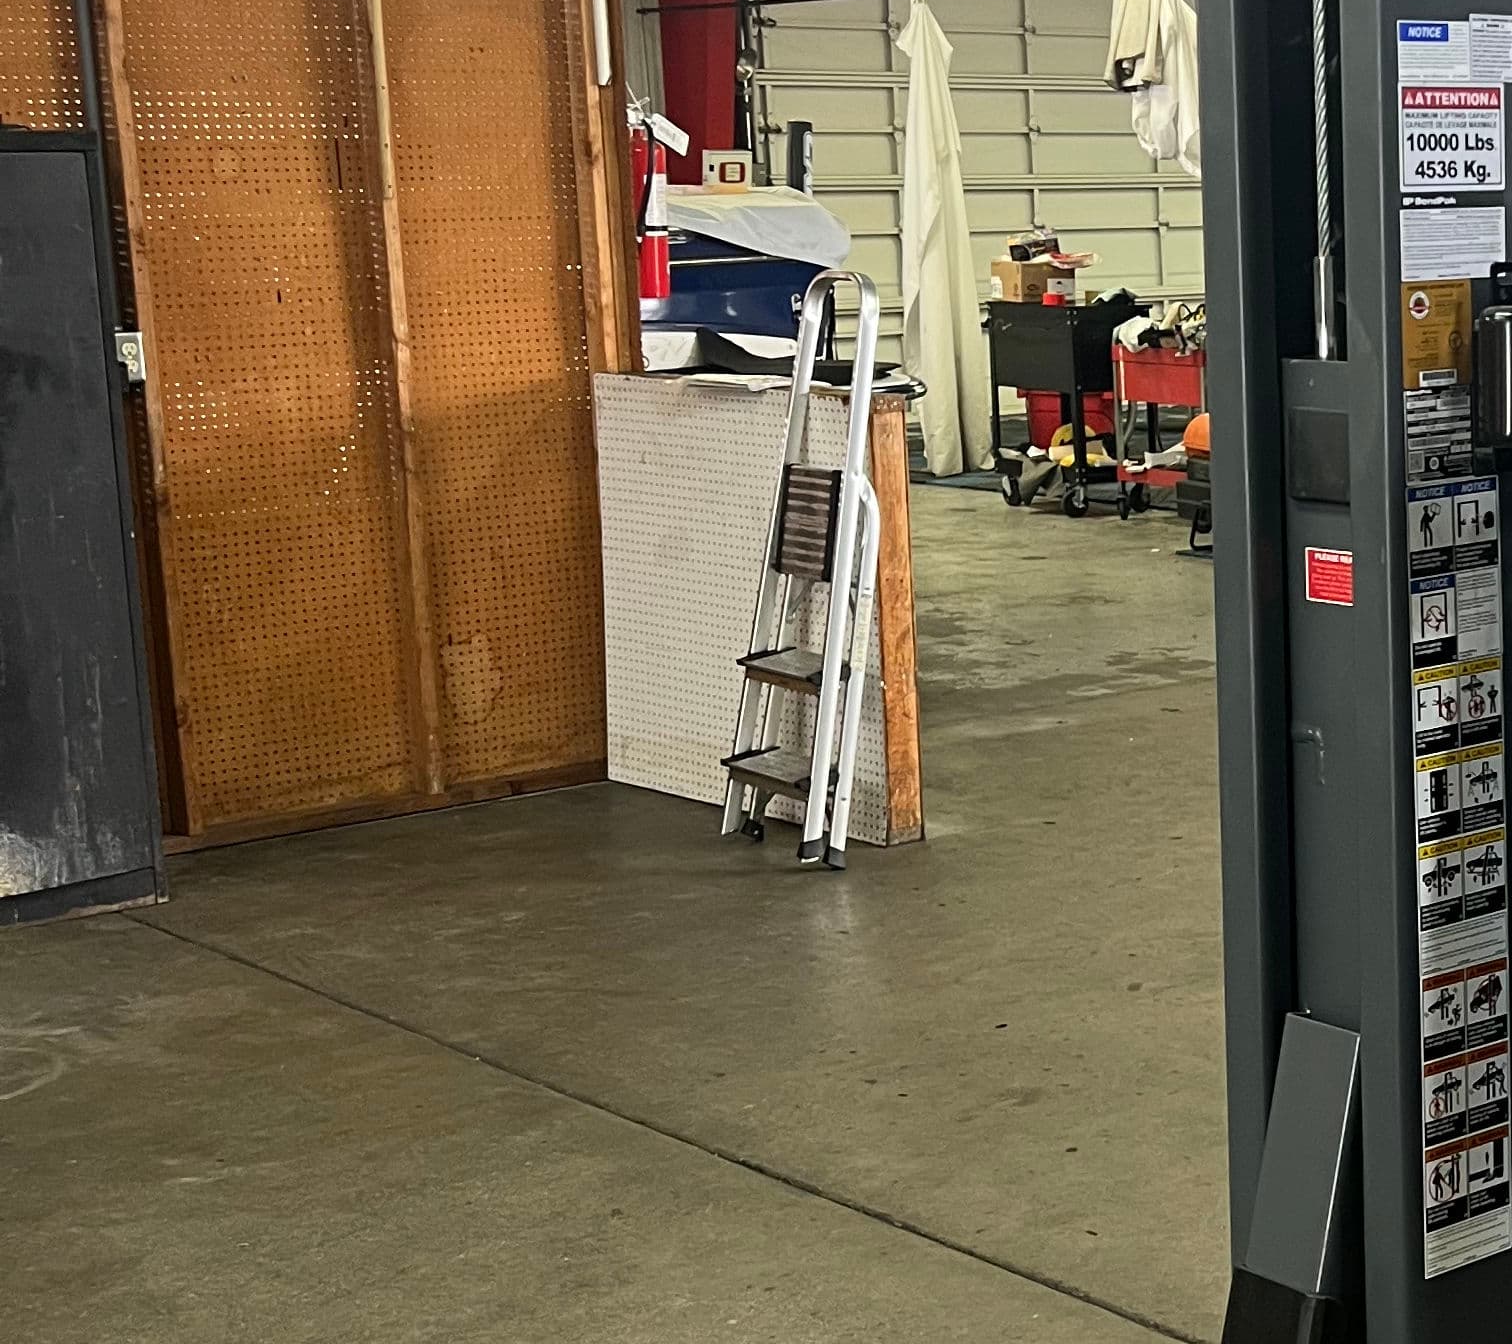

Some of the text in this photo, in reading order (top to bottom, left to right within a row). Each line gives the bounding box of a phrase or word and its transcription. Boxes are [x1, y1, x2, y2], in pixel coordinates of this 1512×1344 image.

[1408, 26, 1442, 38] NOTICE
[1415, 92, 1490, 106] ATTENTION
[1406, 133, 1459, 151] 10000
[1415, 160, 1491, 183] 4536 Kg.
[1415, 486, 1446, 499] NOTICE
[1460, 480, 1491, 493] NOTICE
[1419, 576, 1449, 590] NOTICE
